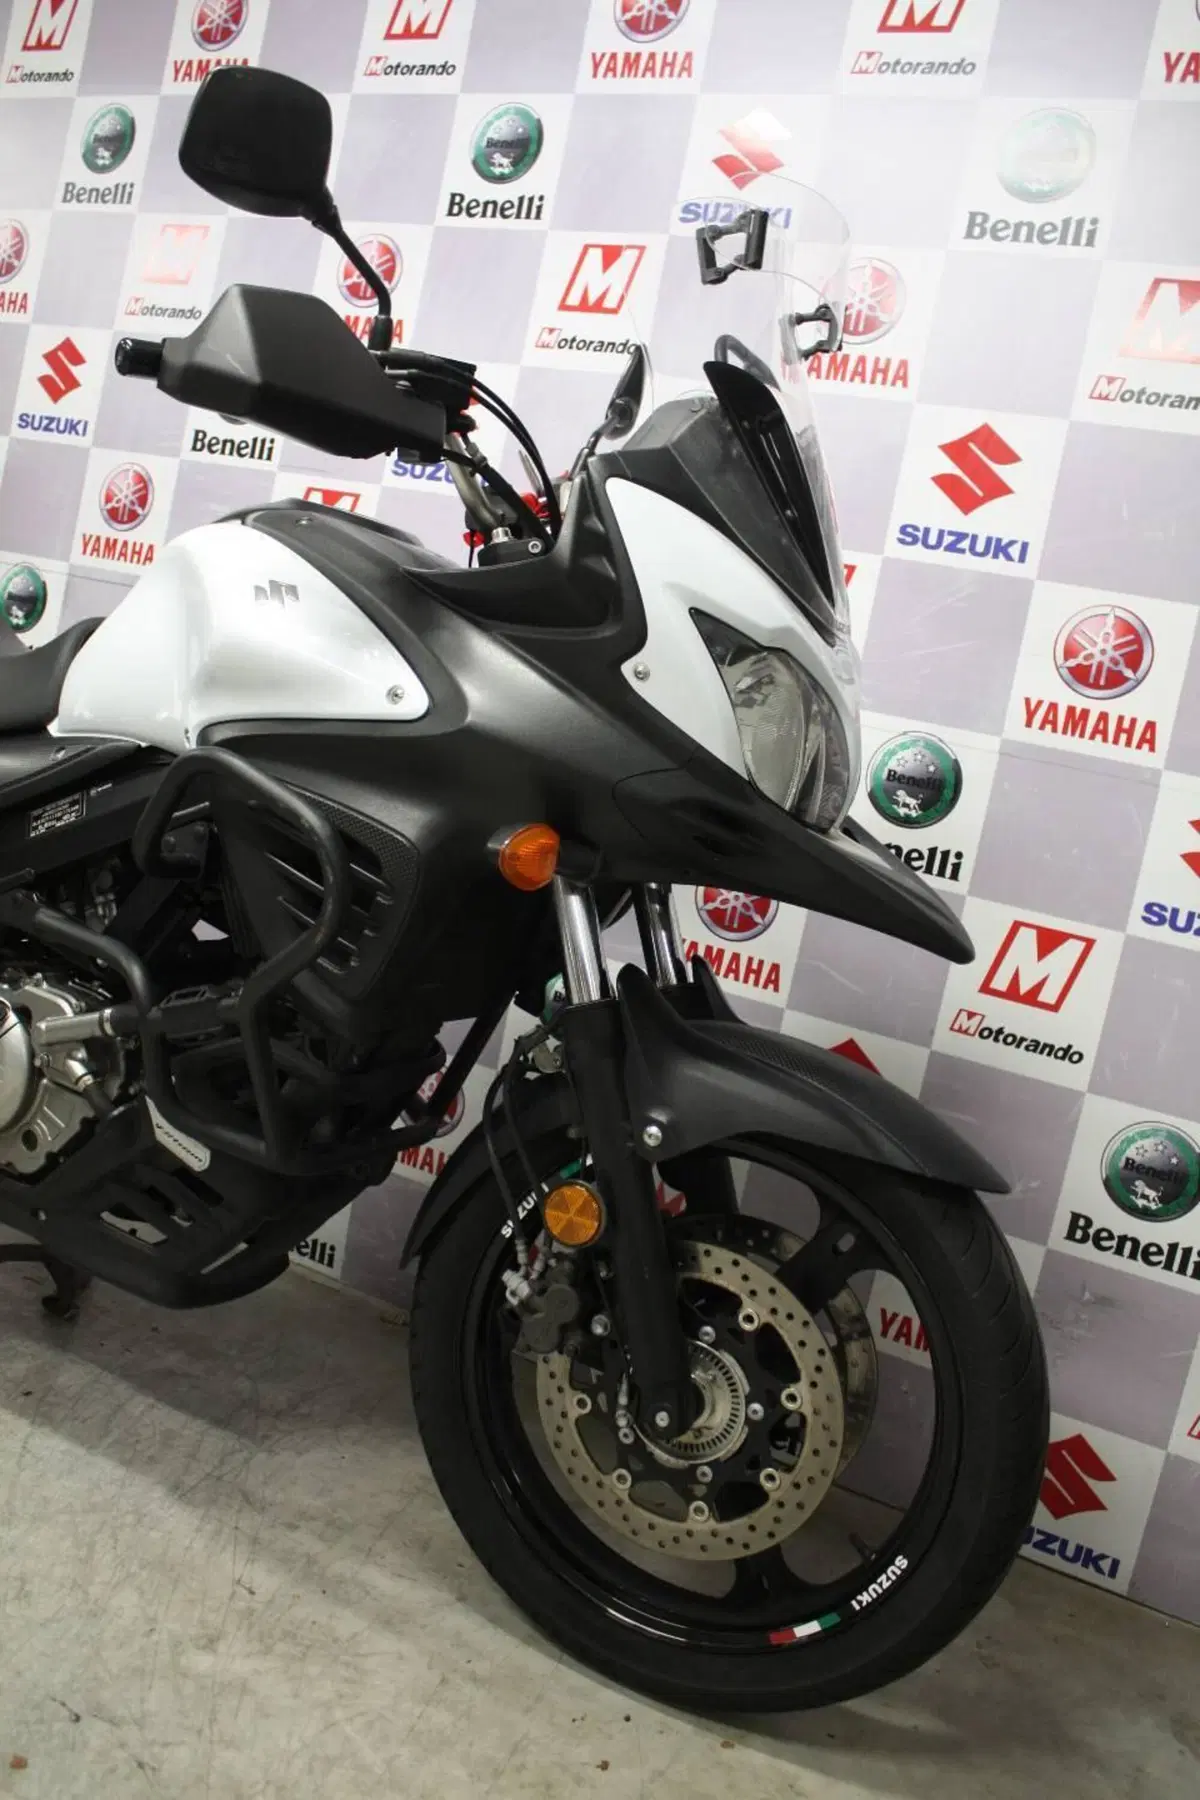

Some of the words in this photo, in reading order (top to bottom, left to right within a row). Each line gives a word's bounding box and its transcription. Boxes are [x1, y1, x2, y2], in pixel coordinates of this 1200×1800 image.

[6, 65, 75, 83] Motorando
[173, 58, 249, 82] YAM
[362, 56, 457, 77] Motorando
[590, 51, 694, 80] YAMAHA
[850, 51, 977, 76] Motorando
[61, 181, 135, 205] Benelli
[446, 192, 545, 221] Benelli
[678, 202, 792, 229] SUZKI
[963, 210, 1100, 248] Benelli
[557, 244, 647, 315] M
[124, 296, 202, 320] Motorando
[787, 351, 909, 388] AMAHA
[17, 412, 89, 438] SUZUKI
[191, 429, 275, 462] Benelli
[81, 532, 156, 566] YAMAHA
[896, 523, 1030, 564] SUZUKI
[1024, 696, 1157, 753] YAMAHA
[682, 937, 780, 993] AMAHA
[978, 919, 1097, 1013] M
[949, 1008, 1084, 1065] Motorando
[850, 1554, 909, 1611] SUZUKI
